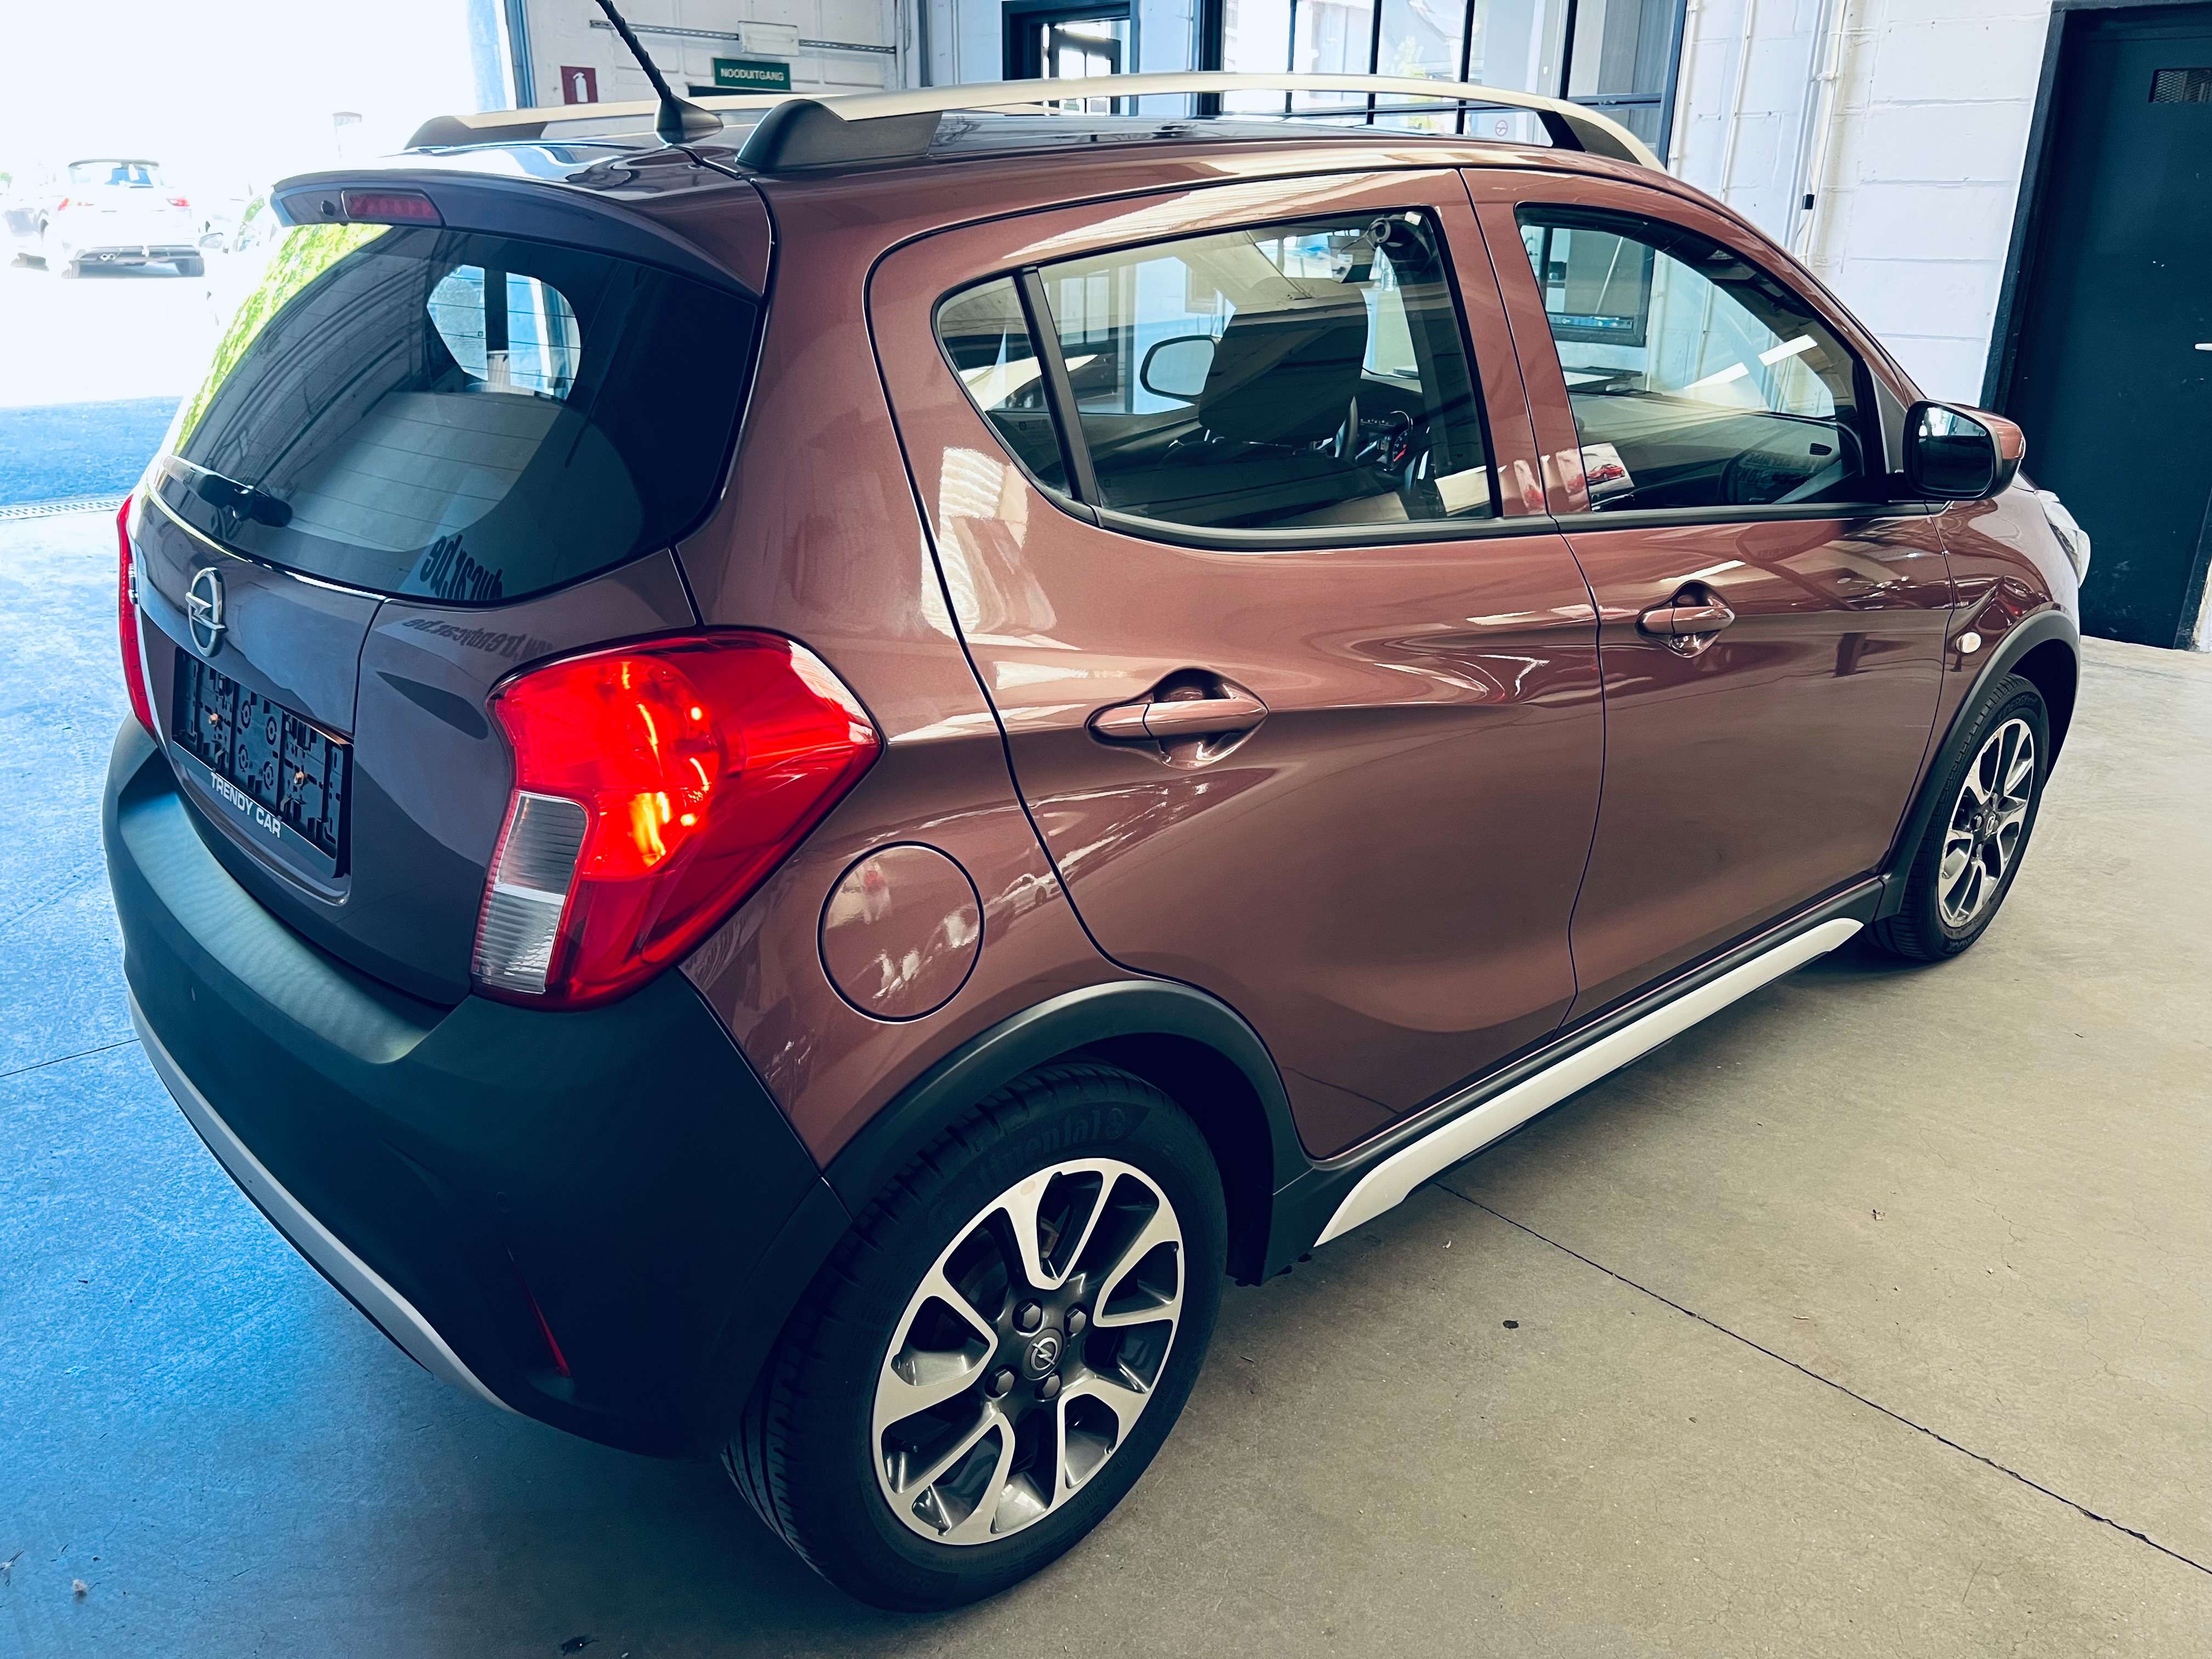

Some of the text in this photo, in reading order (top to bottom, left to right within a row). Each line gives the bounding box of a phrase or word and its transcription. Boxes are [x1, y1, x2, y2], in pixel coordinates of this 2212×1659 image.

[720, 68, 785, 81] NOODUITGANG
[210, 771, 281, 838] TRENDY CAR
